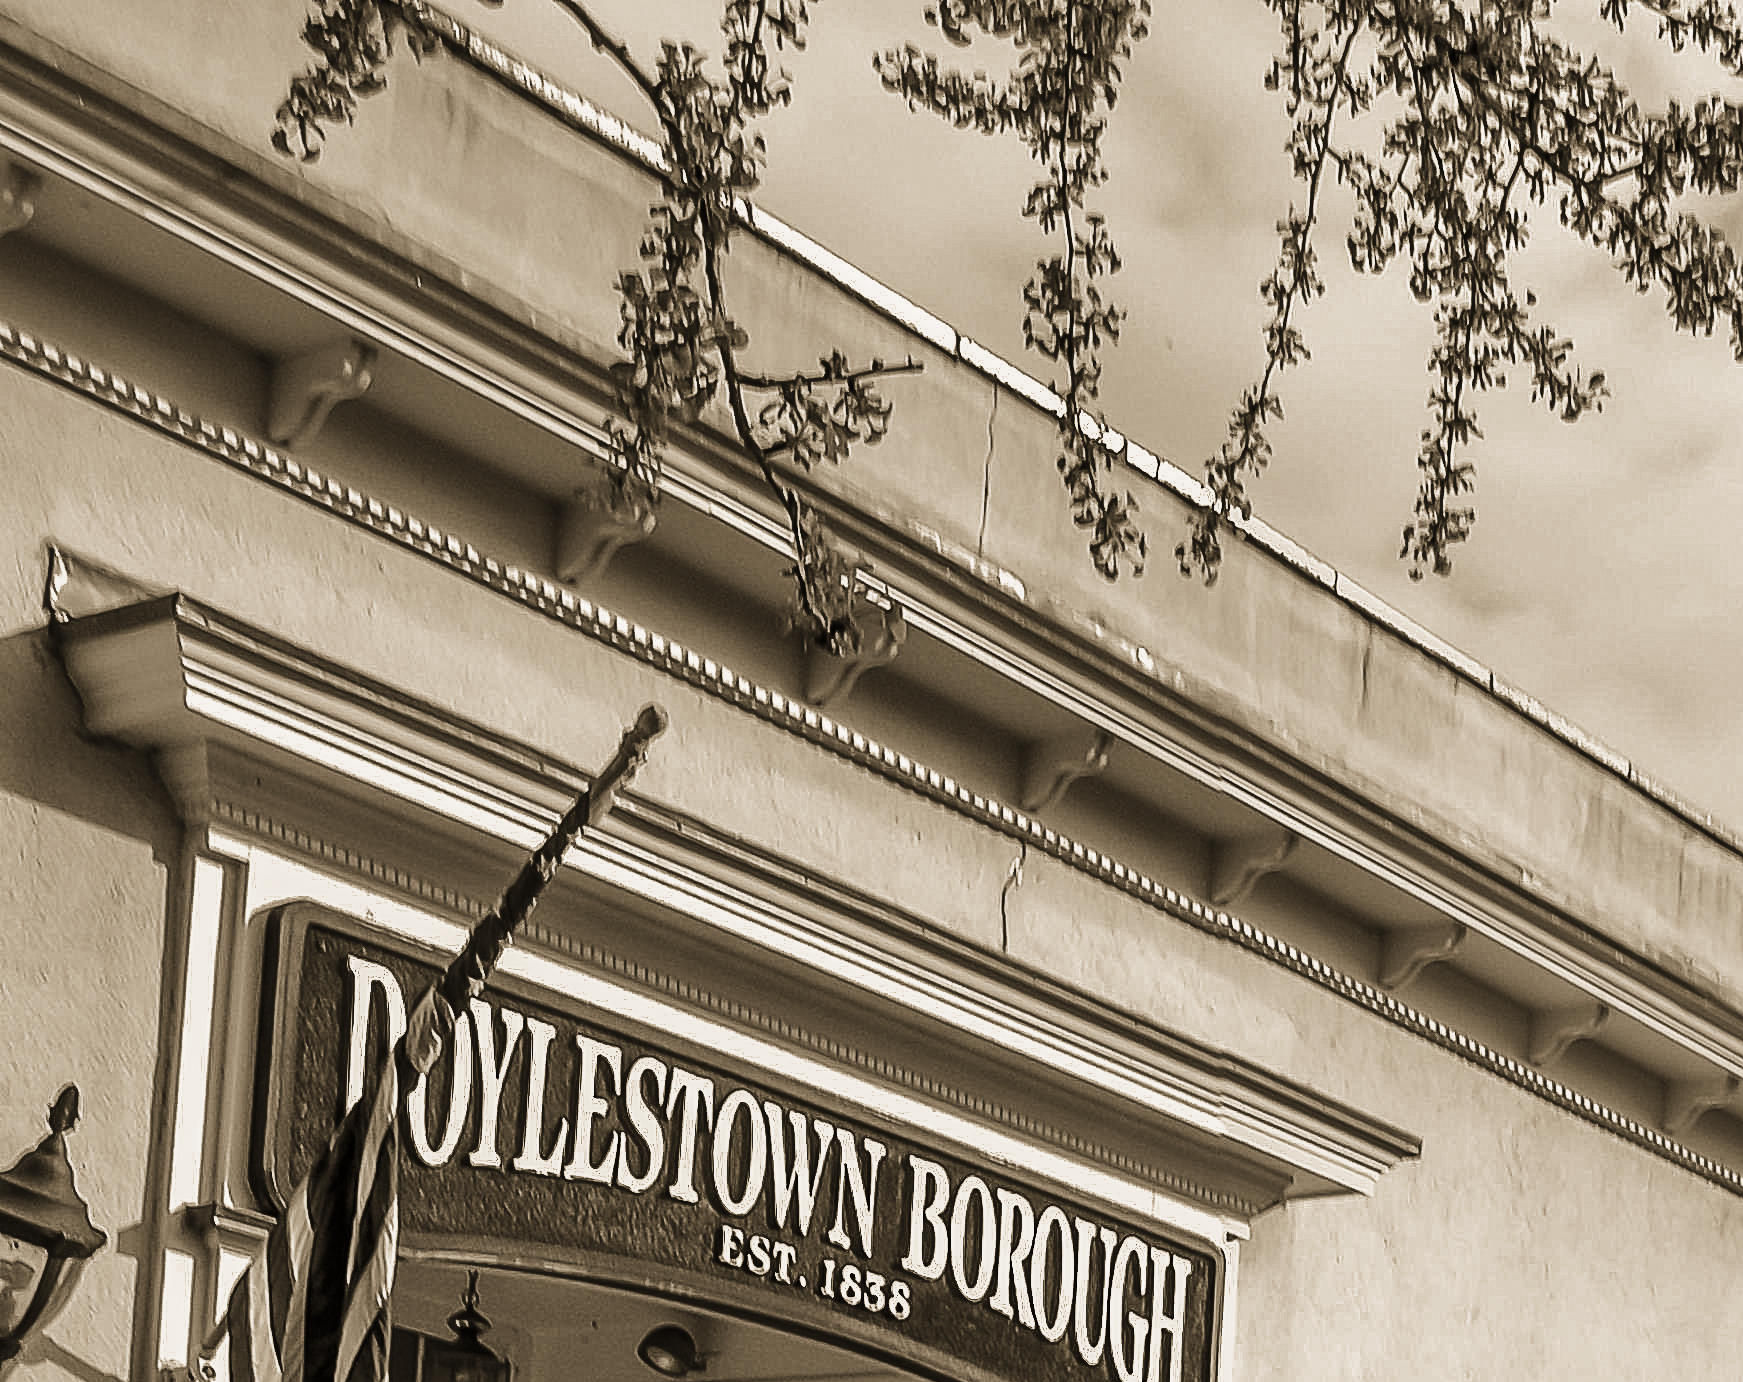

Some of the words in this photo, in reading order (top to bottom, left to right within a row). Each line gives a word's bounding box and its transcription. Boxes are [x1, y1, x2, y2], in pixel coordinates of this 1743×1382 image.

[347, 954, 889, 1259] DOYLESTOWN
[718, 1224, 807, 1289] EST.
[821, 1254, 912, 1321] 1838
